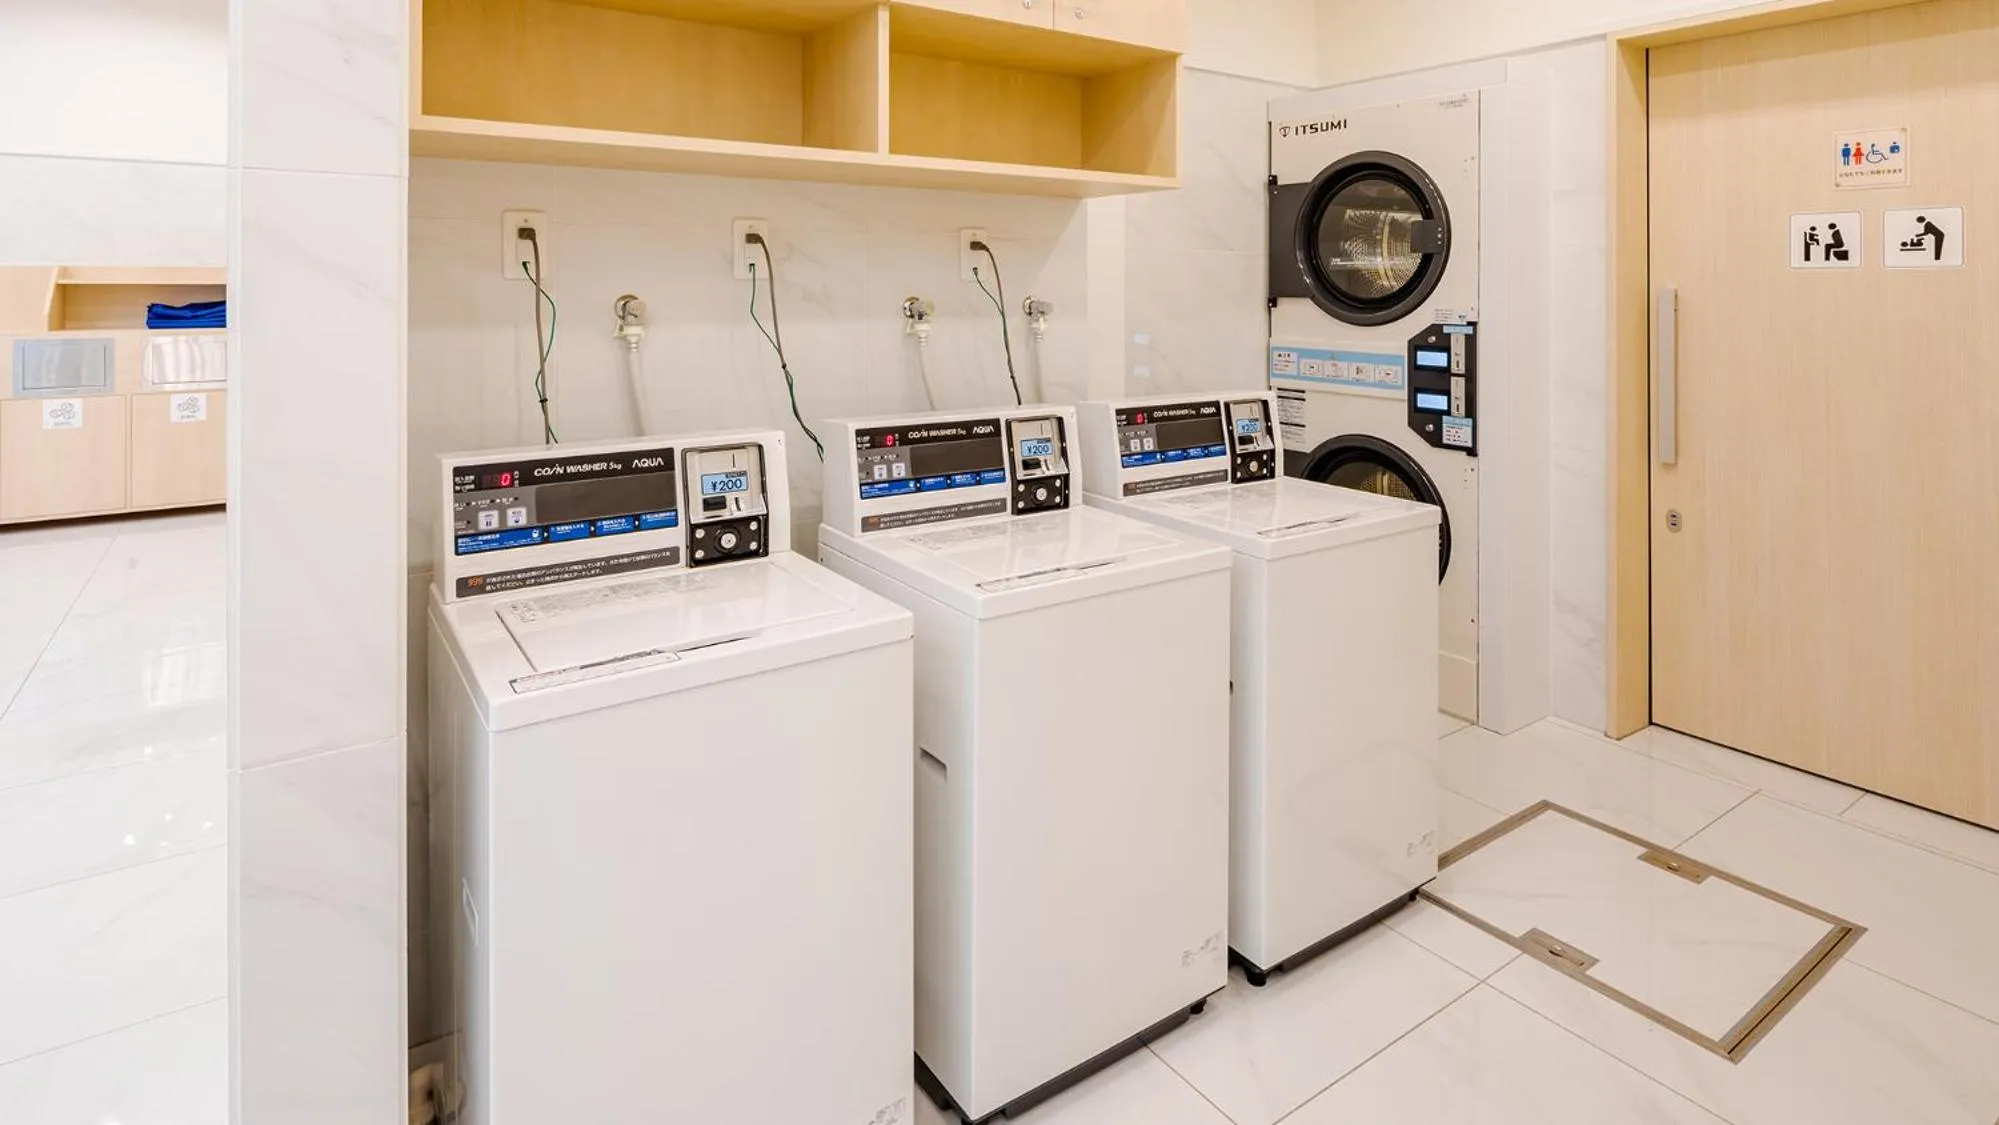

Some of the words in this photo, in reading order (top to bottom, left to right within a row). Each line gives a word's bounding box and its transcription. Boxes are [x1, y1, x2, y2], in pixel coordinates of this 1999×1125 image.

[1295, 119, 1347, 136] ITSUMI
[972, 425, 995, 434] AQUA
[885, 434, 894, 446] 0
[1027, 444, 1050, 455] ¥200
[565, 462, 607, 474] WASHER
[632, 457, 665, 469] AQUA
[500, 473, 511, 486] 0
[711, 478, 743, 492] ¥200
